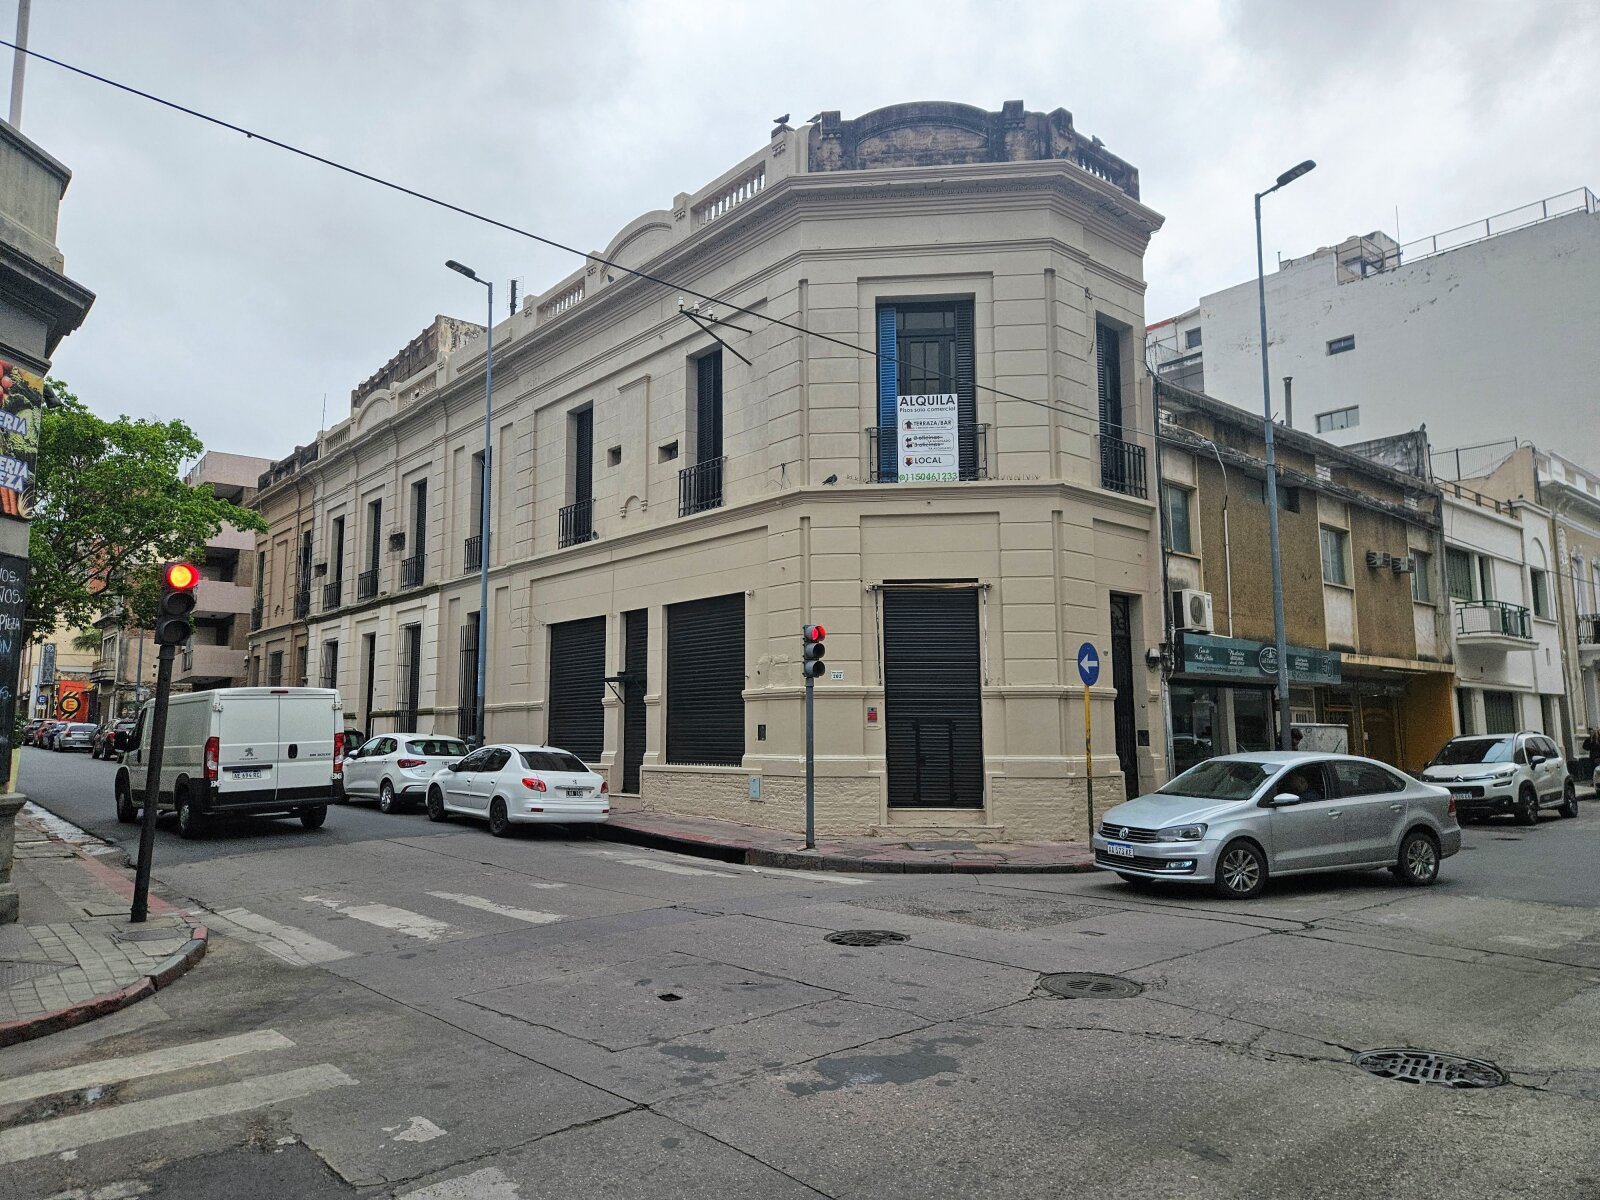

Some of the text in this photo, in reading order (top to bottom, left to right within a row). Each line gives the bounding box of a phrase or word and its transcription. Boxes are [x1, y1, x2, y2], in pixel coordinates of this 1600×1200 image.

[900, 395, 955, 406] ALQUILA
[914, 456, 942, 464] LOCAL
[65, 700, 75, 710] E
